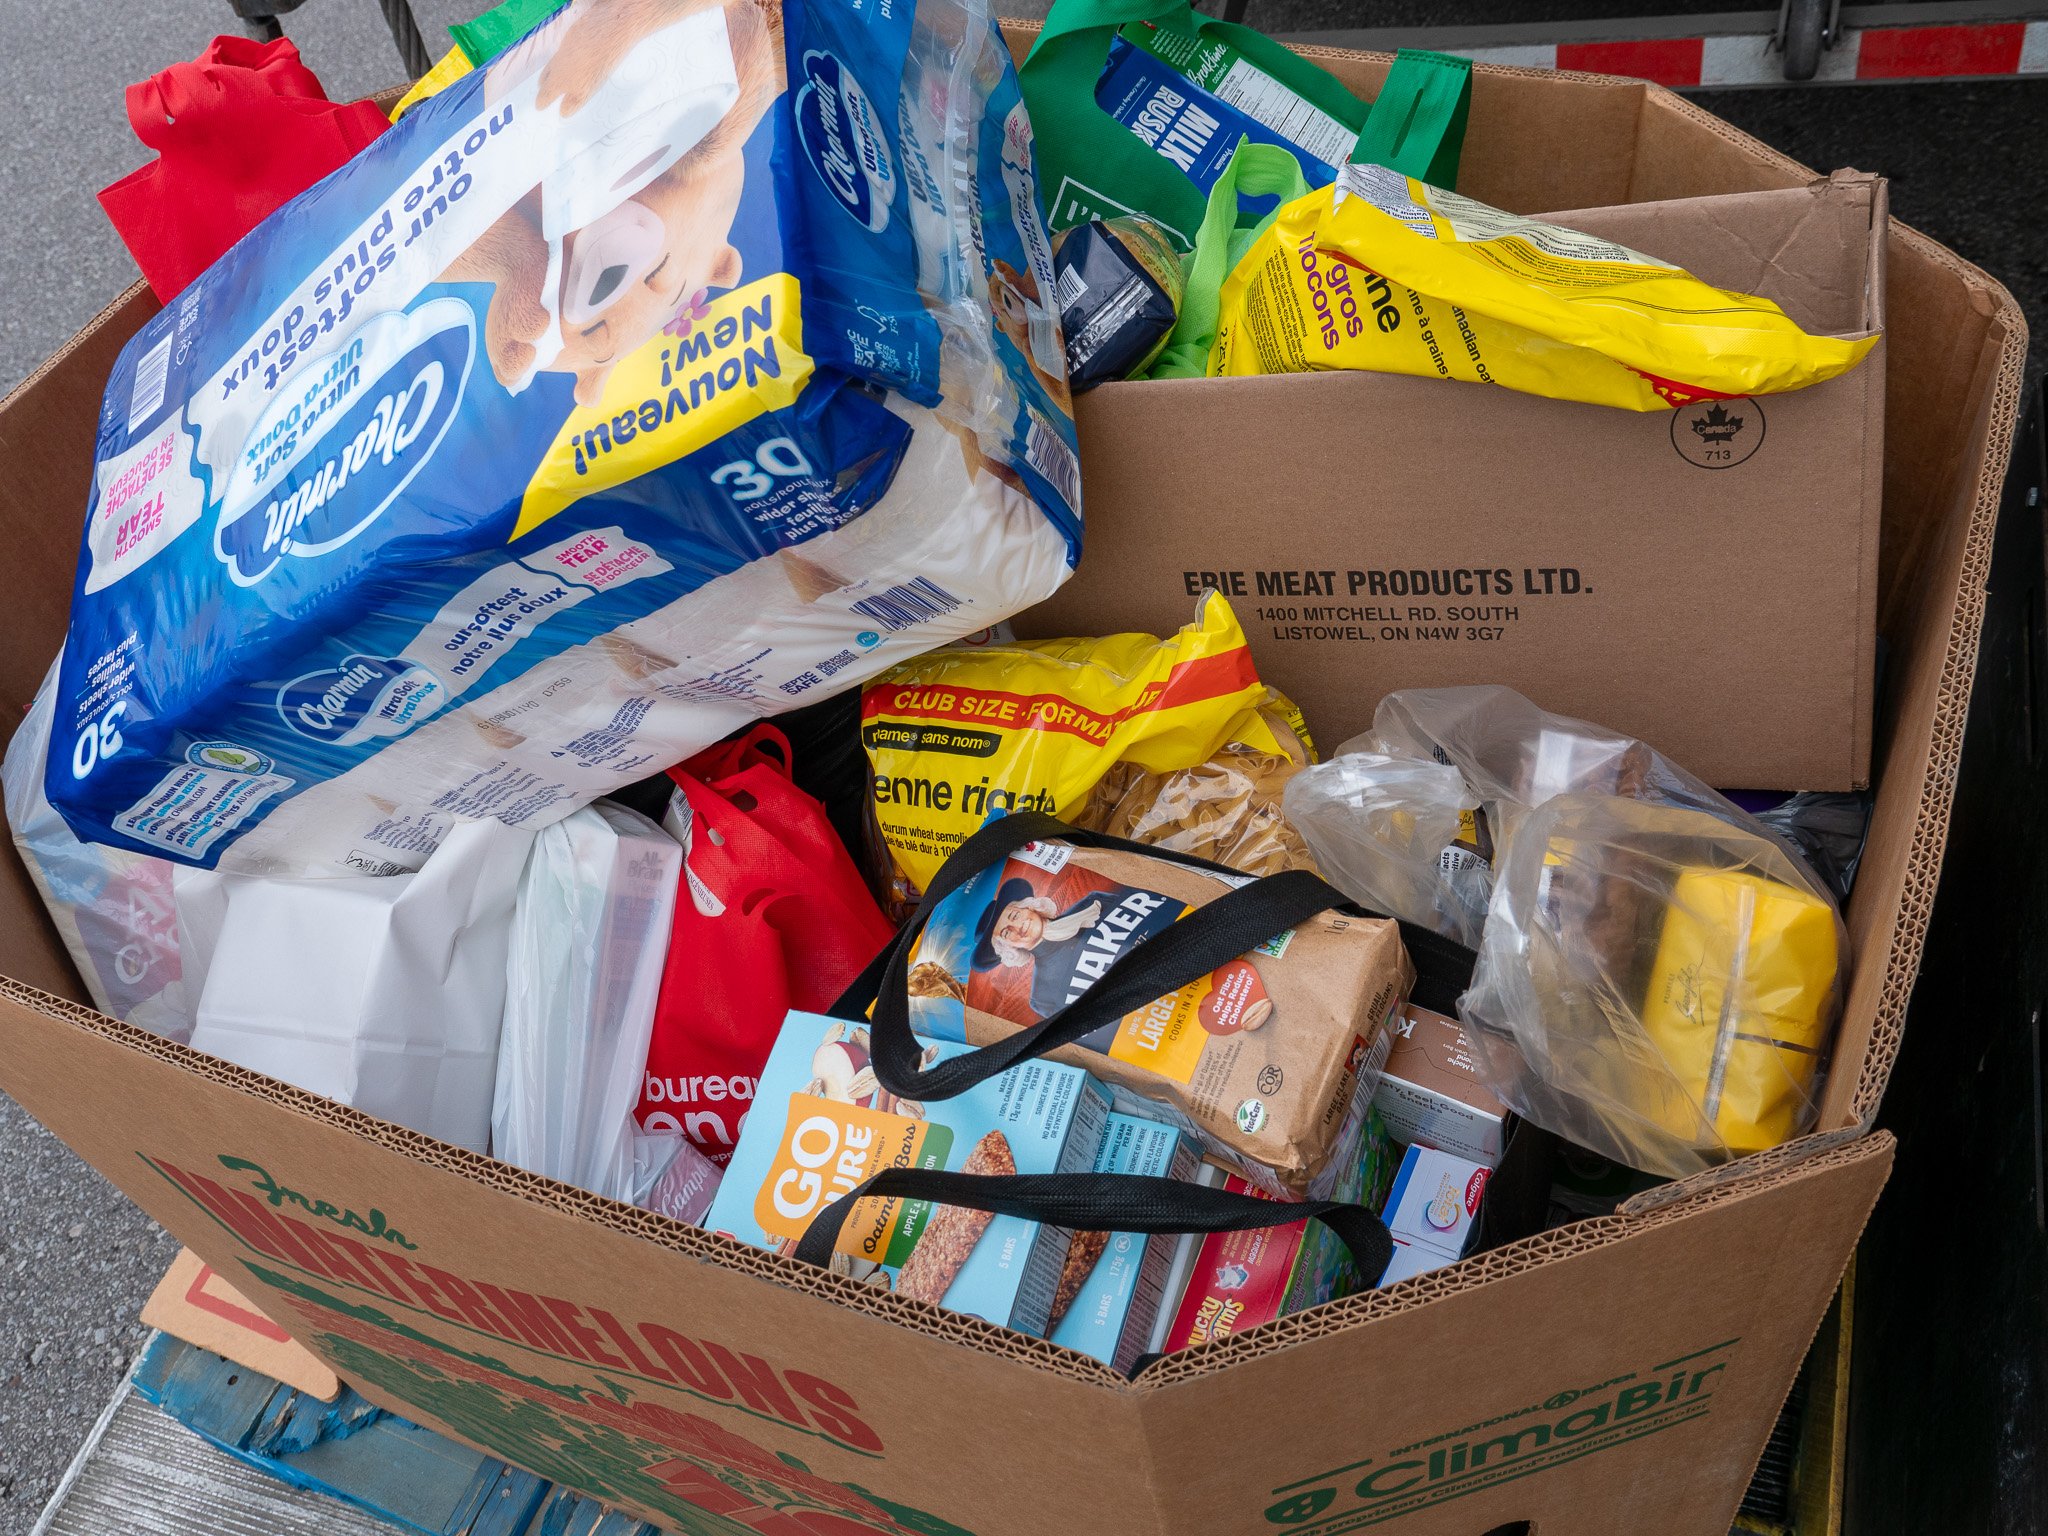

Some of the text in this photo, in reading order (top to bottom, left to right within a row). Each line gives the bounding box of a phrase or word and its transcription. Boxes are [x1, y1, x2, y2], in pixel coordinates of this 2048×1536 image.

[1130, 85, 1186, 148] RUSK
[809, 72, 859, 205] Charmin
[859, 127, 876, 173] Ultra
[1156, 103, 1221, 173] MILK
[870, 137, 890, 181] Ultra
[222, 104, 514, 400] notre plus doux
[264, 173, 472, 390] our softest
[1325, 263, 1364, 339] gros
[660, 294, 773, 387] New!
[1452, 305, 1481, 362] anadian
[1421, 330, 1448, 375] grains
[246, 337, 363, 466] Ultra Doux
[570, 335, 782, 476] Nouveau!
[253, 365, 360, 485] Ultra Soft
[108, 432, 175, 498] EN DOUCEUR
[158, 447, 173, 474] SE
[263, 360, 444, 556] Charmin
[710, 436, 813, 501] 30
[1705, 450, 1731, 461] 713
[116, 490, 165, 546] TEAR
[754, 500, 797, 524] wider
[114, 513, 162, 561] SMOOTH
[554, 534, 597, 563] SMOOTH
[785, 522, 818, 541] plus
[562, 539, 609, 569] TEAR
[582, 544, 642, 584] SE DÉTACHE
[593, 551, 651, 588] EN DOUCEUR
[1183, 568, 1593, 597] ERIE MEAT PRODUCTS LTD.
[444, 585, 529, 652] our softest
[450, 586, 569, 676] notre doux
[1256, 607, 1519, 622] 1400 MITCHELL RD. SOUTH
[1274, 627, 1505, 643] LISTOWEL, ON N4W 3G7
[87, 630, 138, 680] plus larges
[91, 655, 125, 688] feuilles
[108, 661, 136, 688] wider
[542, 677, 572, 698] 0759
[779, 671, 814, 690] SEPTIC
[787, 674, 823, 698] SAFE
[297, 664, 383, 730] Charmin
[894, 691, 957, 712] CLUB
[959, 696, 1018, 721] SIZE
[72, 700, 128, 781] 30
[921, 733, 949, 745] sans
[874, 774, 952, 811] enne
[882, 822, 934, 840] durum wheat
[905, 838, 933, 855] blé dur
[1443, 851, 1451, 870] acts
[1065, 892, 1160, 1006] UAKER
[1212, 973, 1235, 1014] Oat Fibre
[1217, 968, 1248, 1026] Helps Reduce
[1367, 991, 1382, 1020] GRUAU
[1376, 983, 1394, 1019] FLOCONS
[1136, 1000, 1176, 1051] LARGE
[1169, 1013, 1186, 1042] COOKS
[1034, 1067, 1042, 1079] BAR
[1260, 1067, 1281, 1094] COR
[1447, 1056, 1471, 1072] Mocha
[999, 1077, 1009, 1093] MADE
[999, 1074, 1017, 1117] 100% CANADIAN
[1018, 1066, 1035, 1103] WHOLE GRAIN
[1036, 1070, 1055, 1115] SOURCE FIBRE
[1045, 1073, 1067, 1129] ARTIFICIAL FLAVOURS
[1054, 1074, 1076, 1129] SYNTHETIC COLOURS
[1323, 1071, 1350, 1125] LARGE FLAKE
[1336, 1092, 1350, 1114] OATS
[1400, 1092, 1443, 1115] Snacks
[1407, 1088, 1474, 1121] Feel-Good
[876, 1140, 885, 1159] OWNED
[1097, 1130, 1110, 1159] CANADIAN
[1113, 1123, 1127, 1159] WHOLE GRAIN
[1122, 1124, 1135, 1148] PER BAR
[1128, 1128, 1148, 1173] SOURCE FIBRE
[1148, 1130, 1161, 1157] FLAVOURS
[1155, 1132, 1168, 1157] COLOURS
[773, 1116, 840, 1219] GO
[820, 1123, 873, 1208] URE
[217, 1154, 419, 1251] Fresh
[1466, 1172, 1483, 1207] Colgate
[902, 1207, 919, 1237] APPLE
[1002, 1235, 1016, 1258] BARS
[152, 1157, 886, 1453] WATERMELONS
[1098, 1293, 1113, 1316] BARS
[1189, 1295, 1222, 1345] ucky
[1389, 1404, 1544, 1458] INTERNATIONAL
[1325, 1495, 1427, 1533] proprietary
